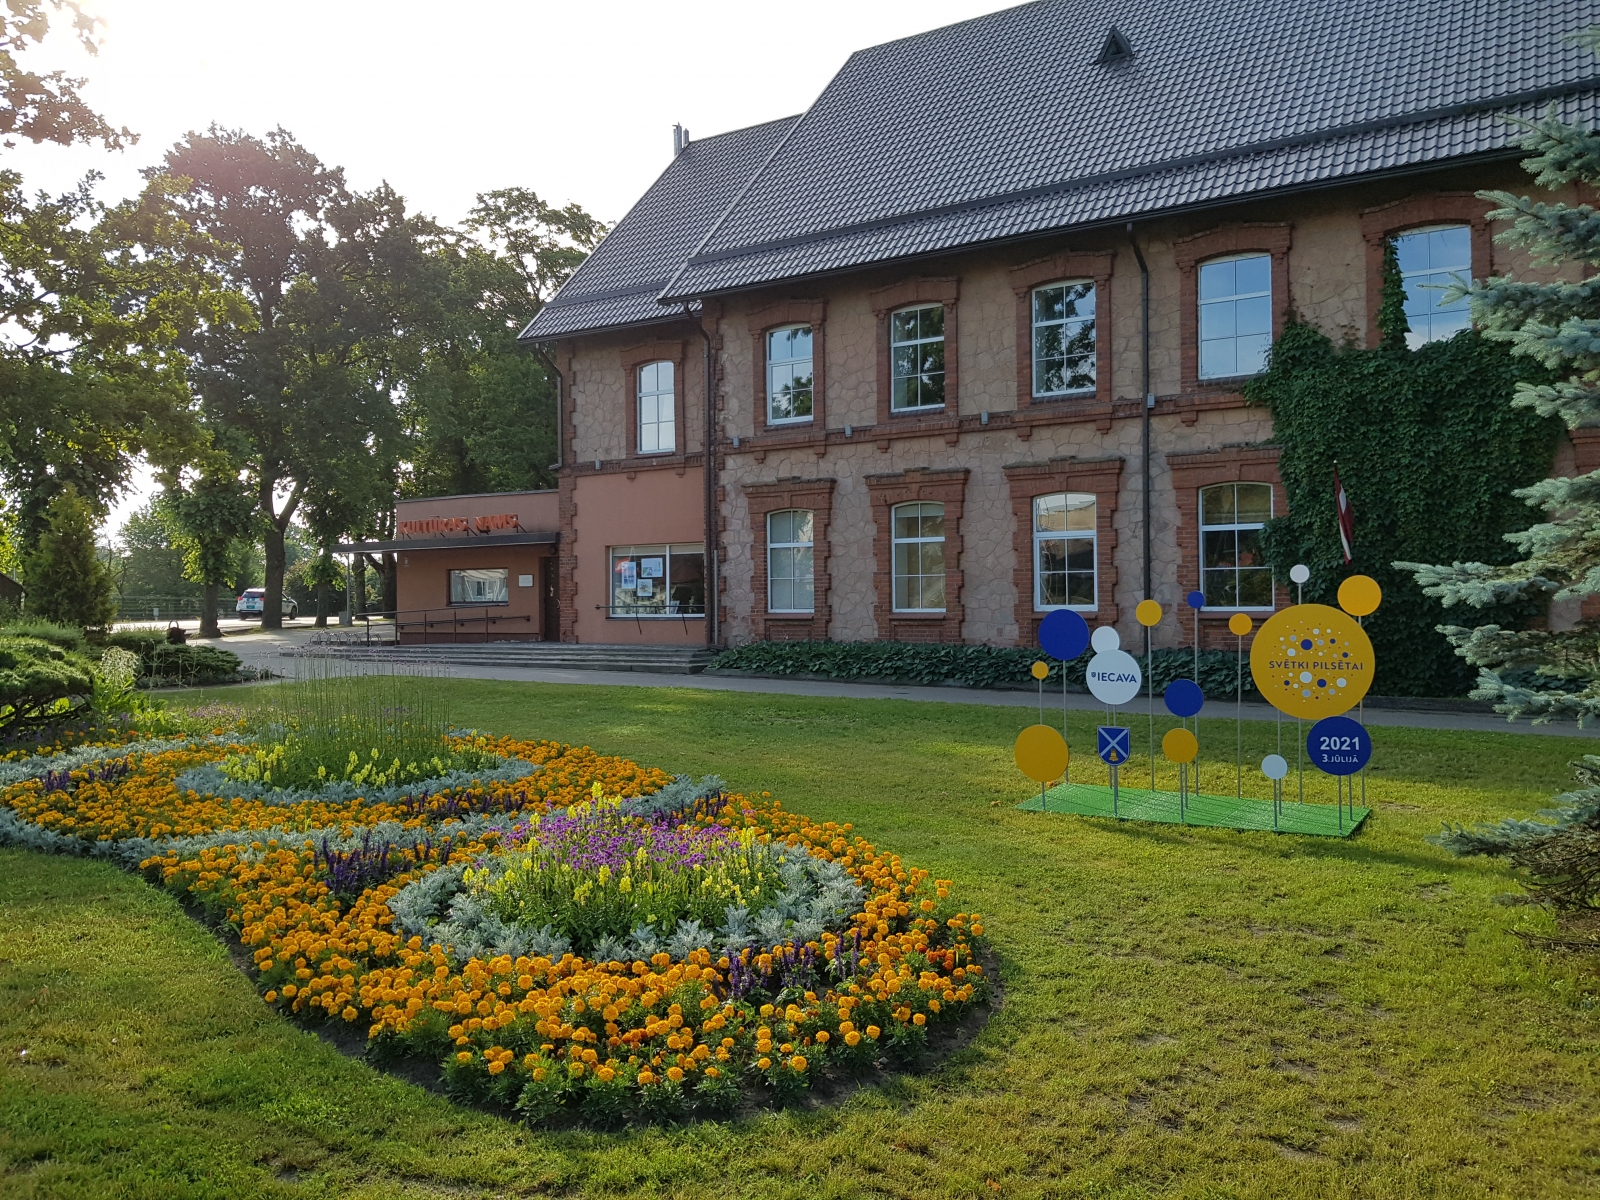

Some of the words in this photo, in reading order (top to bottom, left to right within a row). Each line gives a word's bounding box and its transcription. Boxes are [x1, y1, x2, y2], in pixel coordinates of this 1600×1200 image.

[474, 514, 518, 531] NAMS
[1269, 659, 1309, 669] SVĒTKI
[1313, 659, 1364, 671] PILSĒTAI
[1097, 672, 1137, 683] IECAVA
[1319, 736, 1360, 751] 2021
